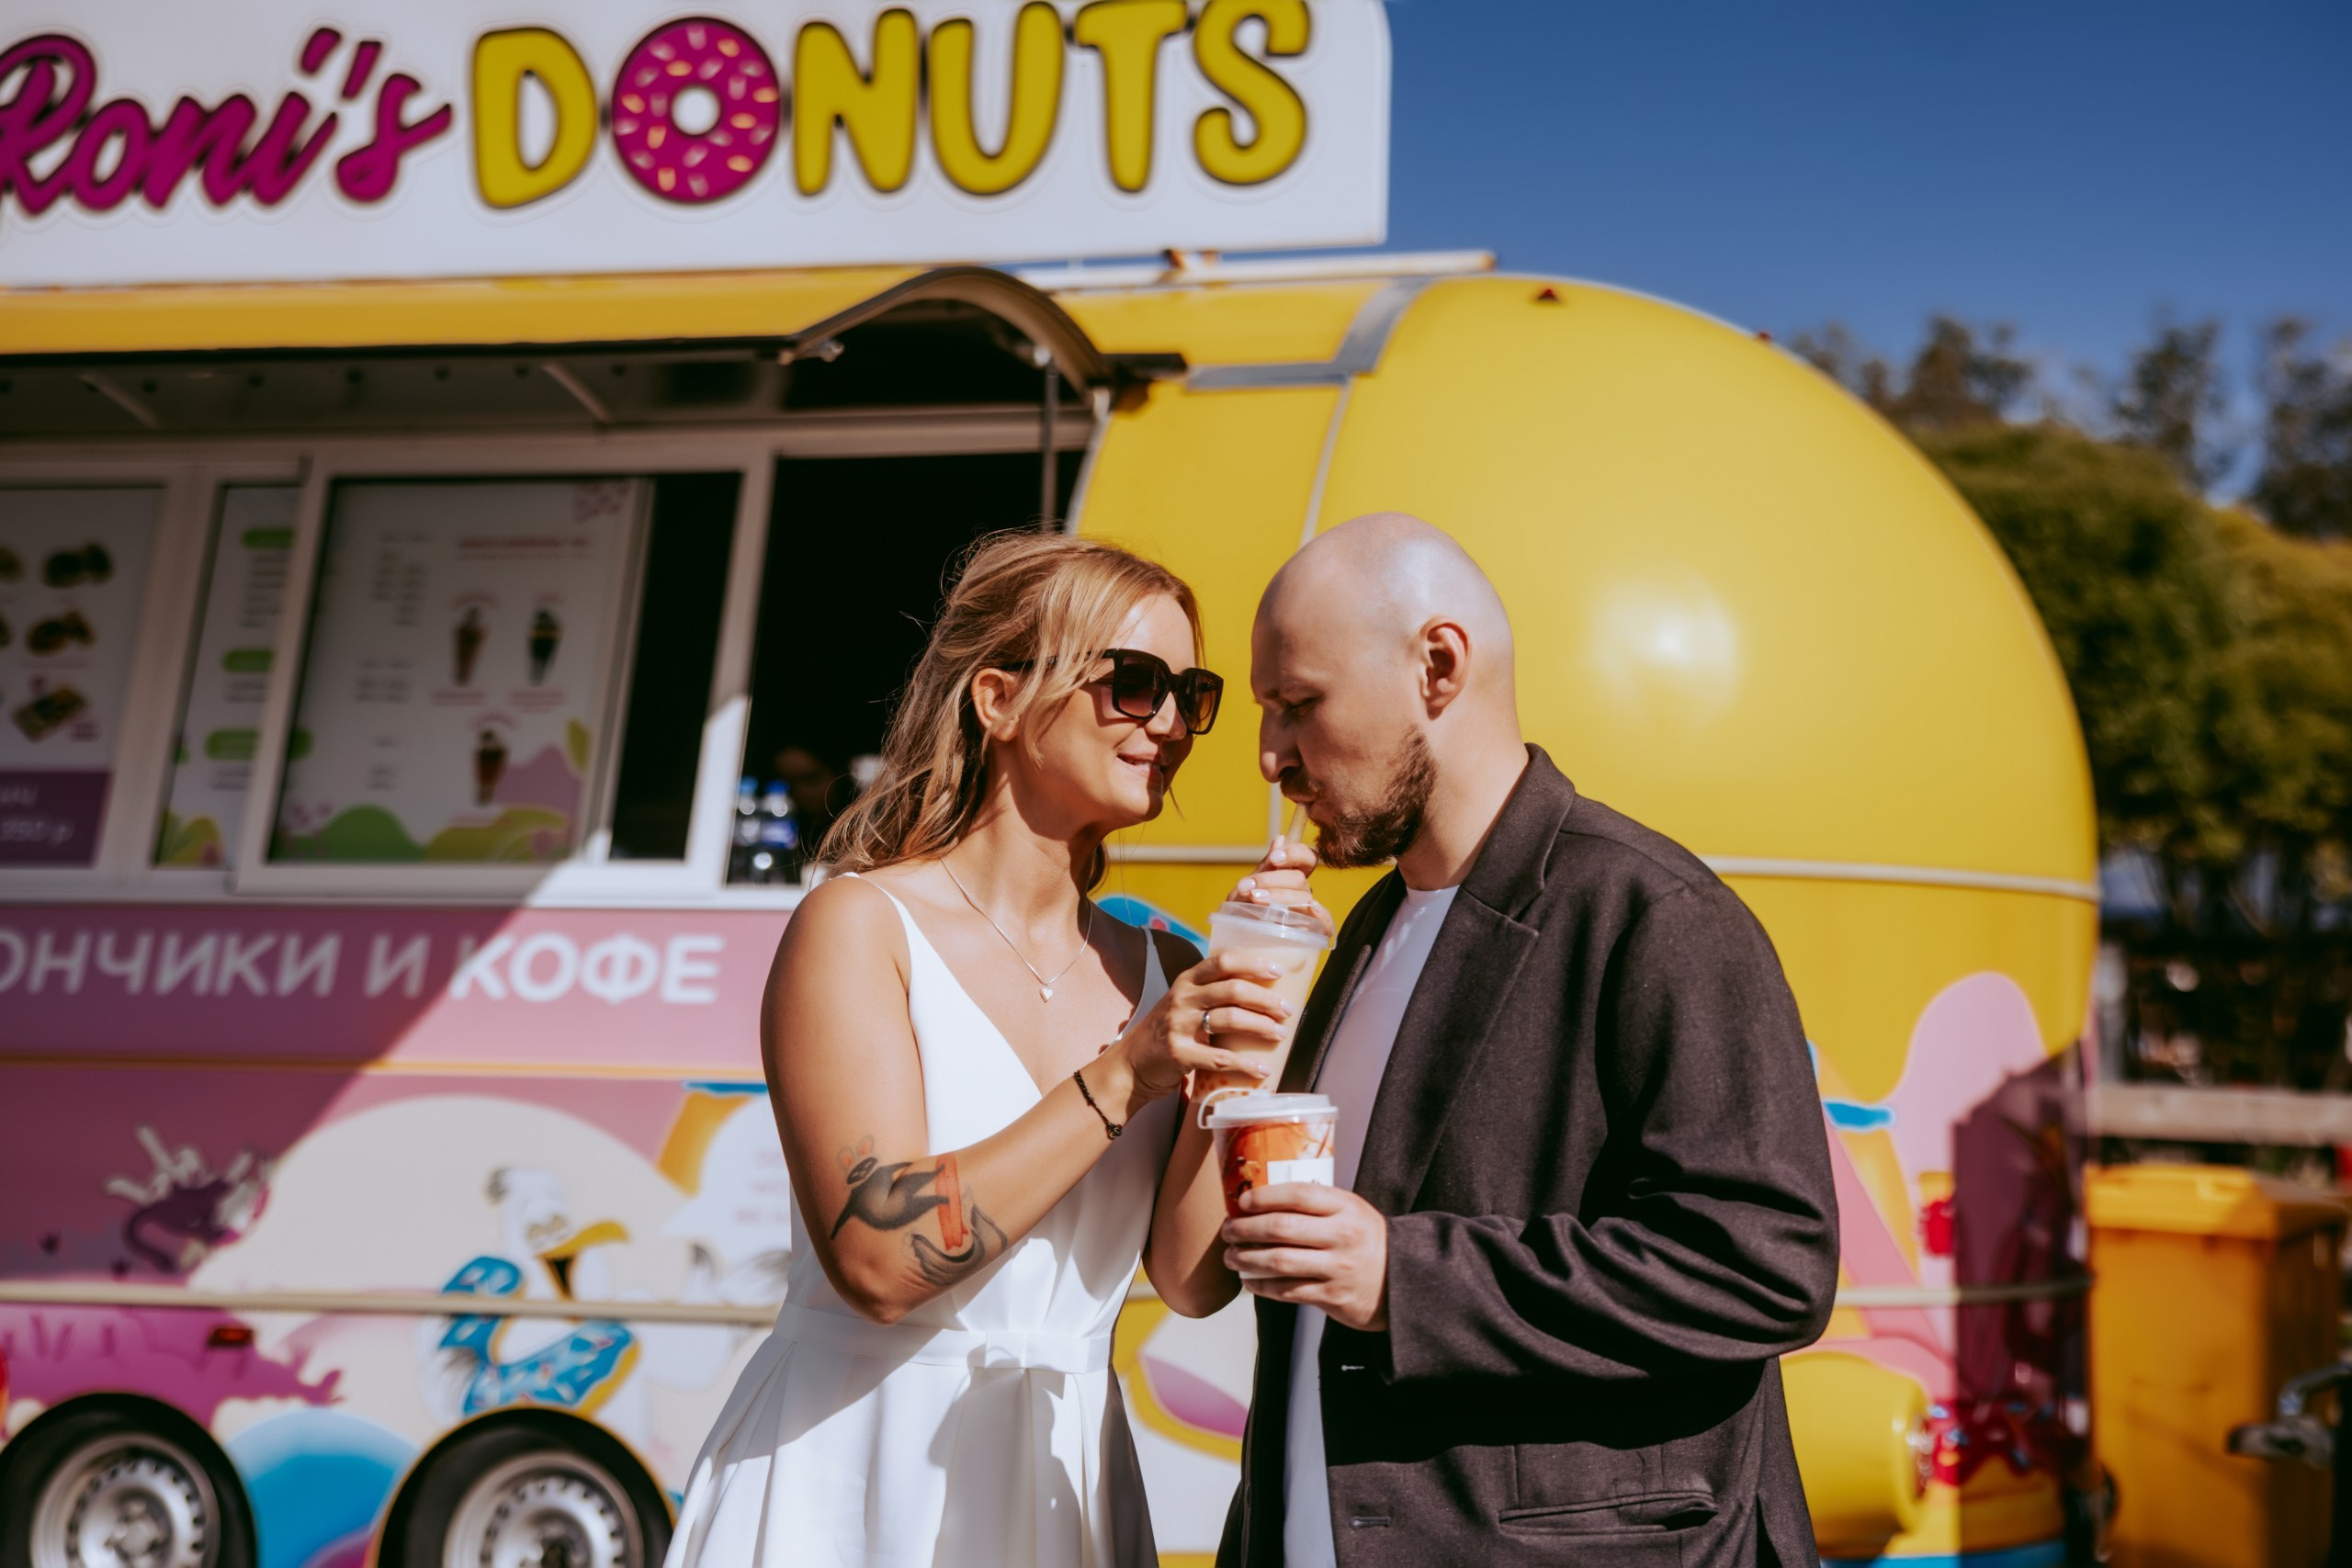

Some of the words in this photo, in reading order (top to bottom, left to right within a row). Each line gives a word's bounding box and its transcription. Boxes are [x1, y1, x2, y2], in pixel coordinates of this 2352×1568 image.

[471, 0, 1312, 210] DONUTS
[364, 932, 432, 999] И
[448, 931, 727, 1005] КОФЕ
